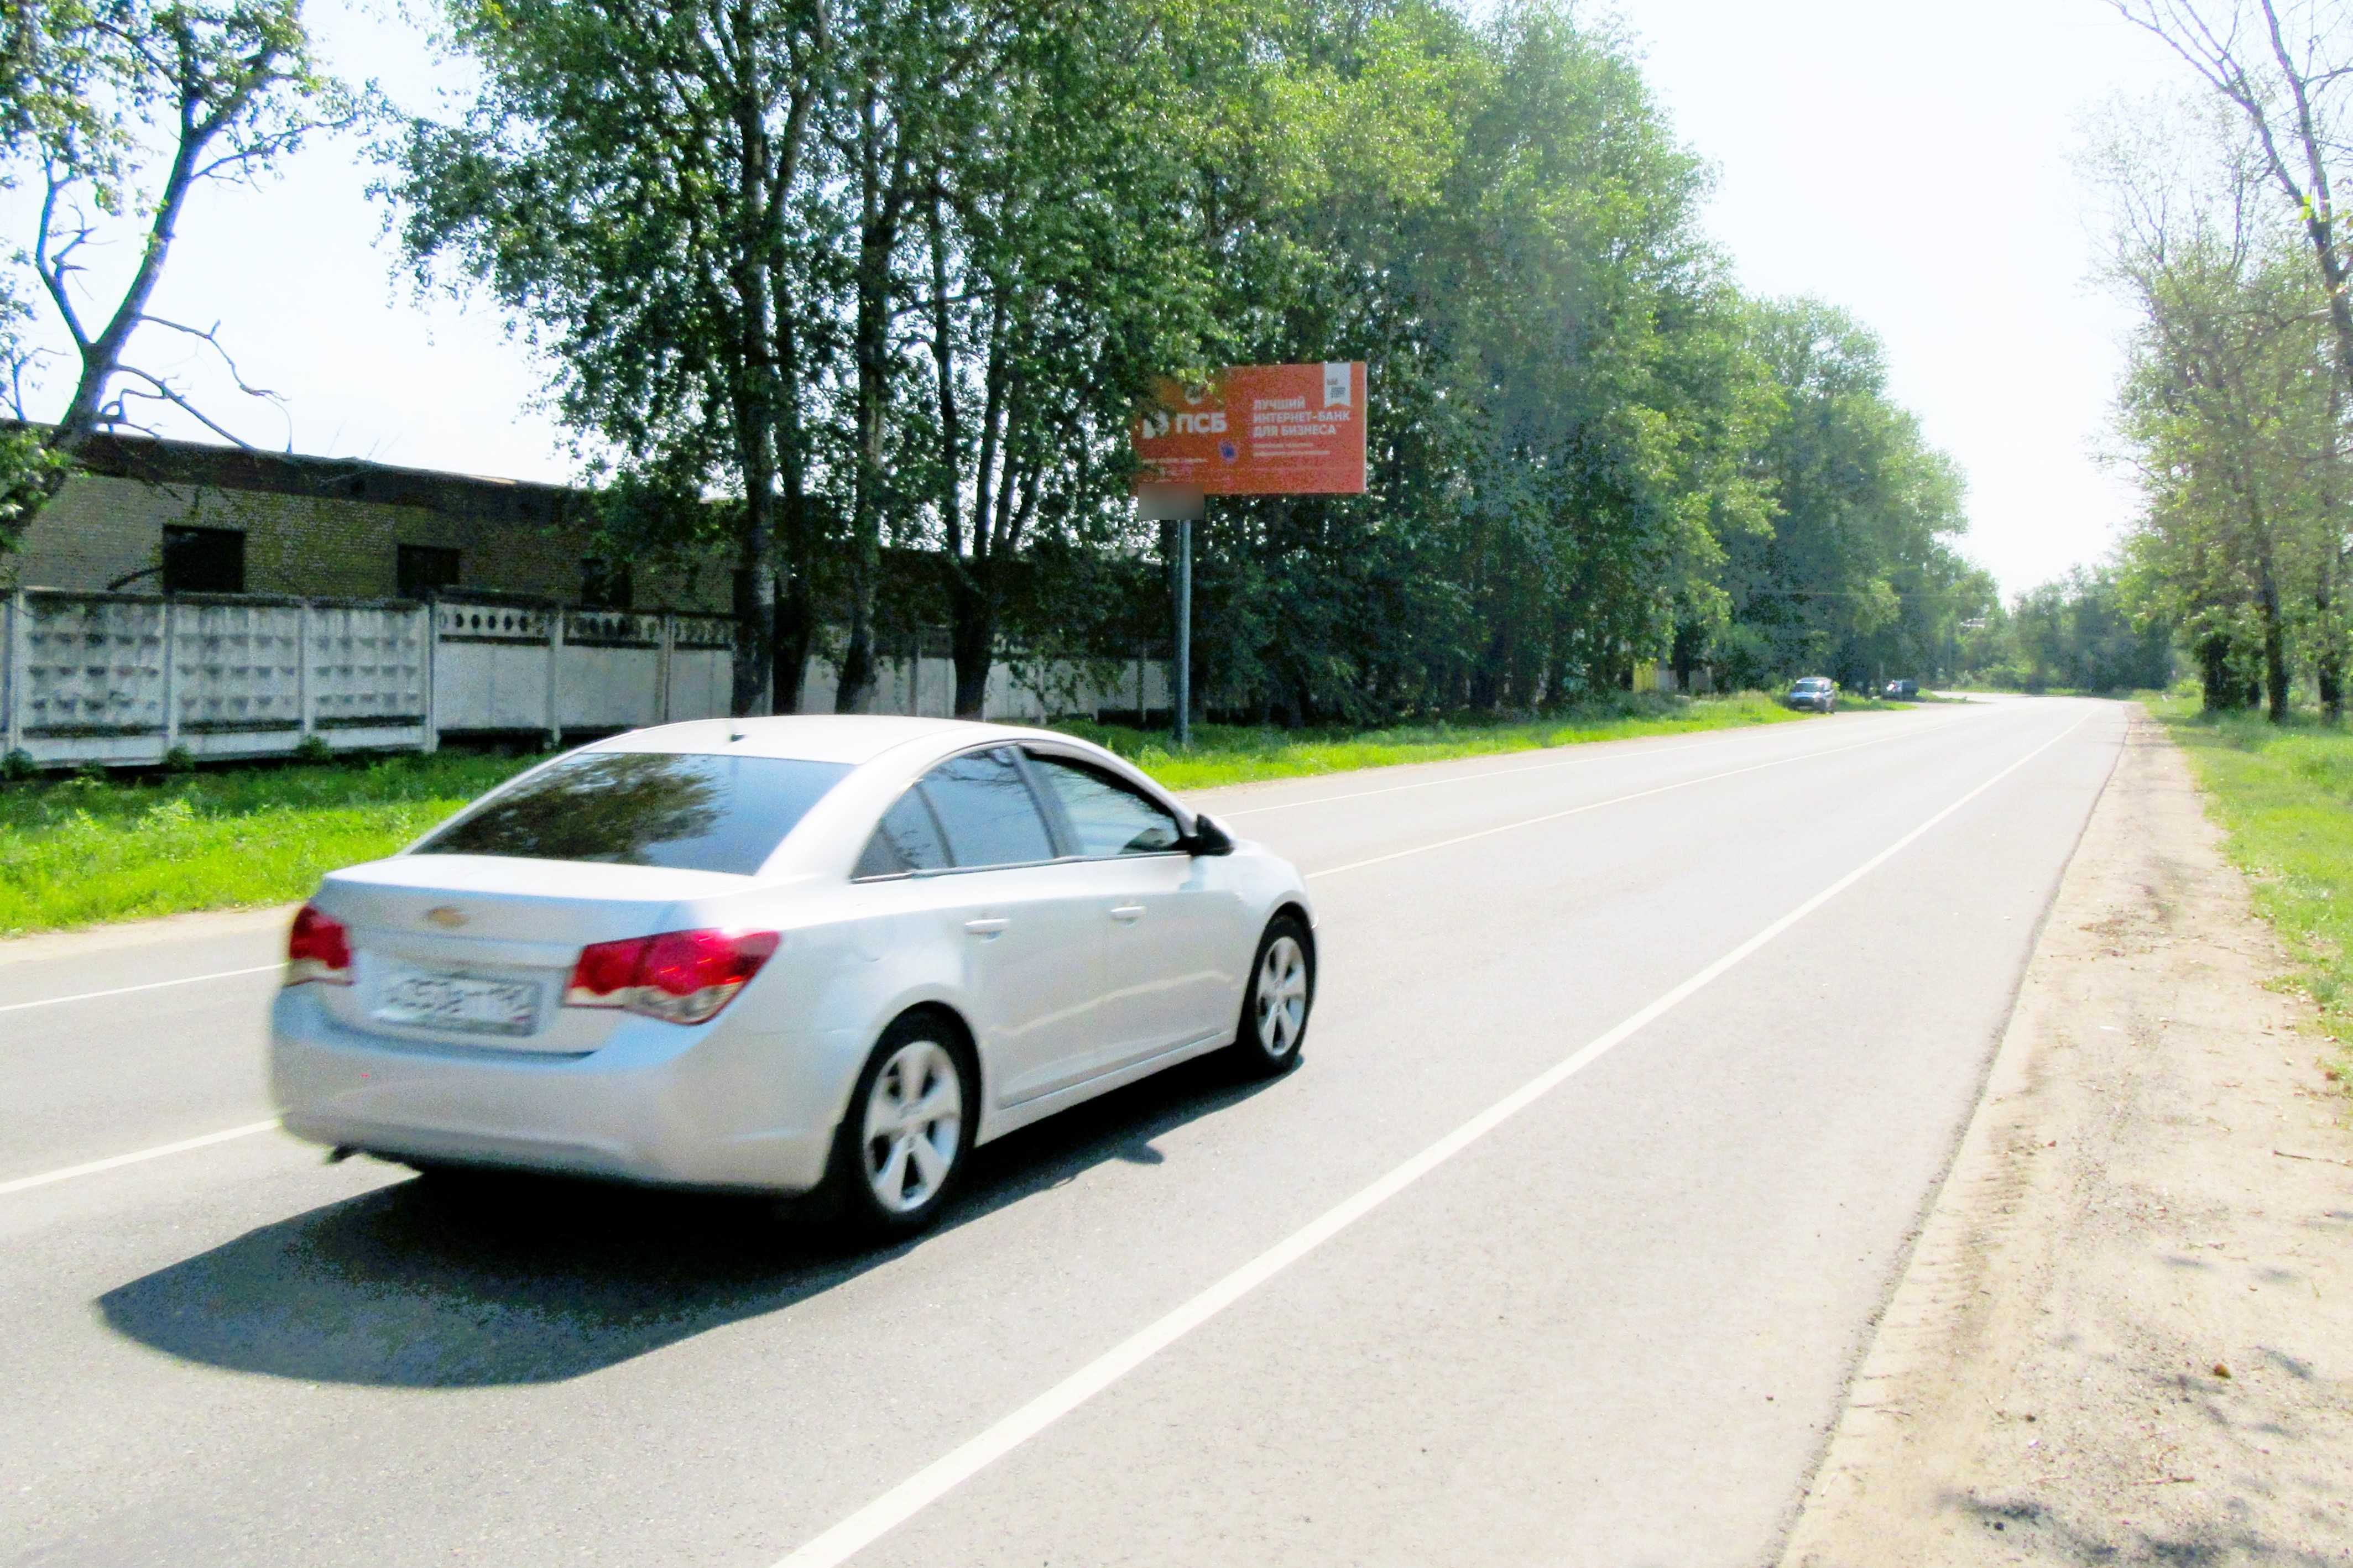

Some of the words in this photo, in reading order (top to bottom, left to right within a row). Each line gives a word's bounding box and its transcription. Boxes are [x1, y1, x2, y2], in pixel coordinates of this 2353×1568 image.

[1254, 396, 1306, 410] ЛУЧШИЙ
[1176, 412, 1228, 434] ПСБ
[1253, 410, 1350, 424] ИНТЕРНЕТ-БАНК
[1253, 425, 1279, 438] ДЛЯ
